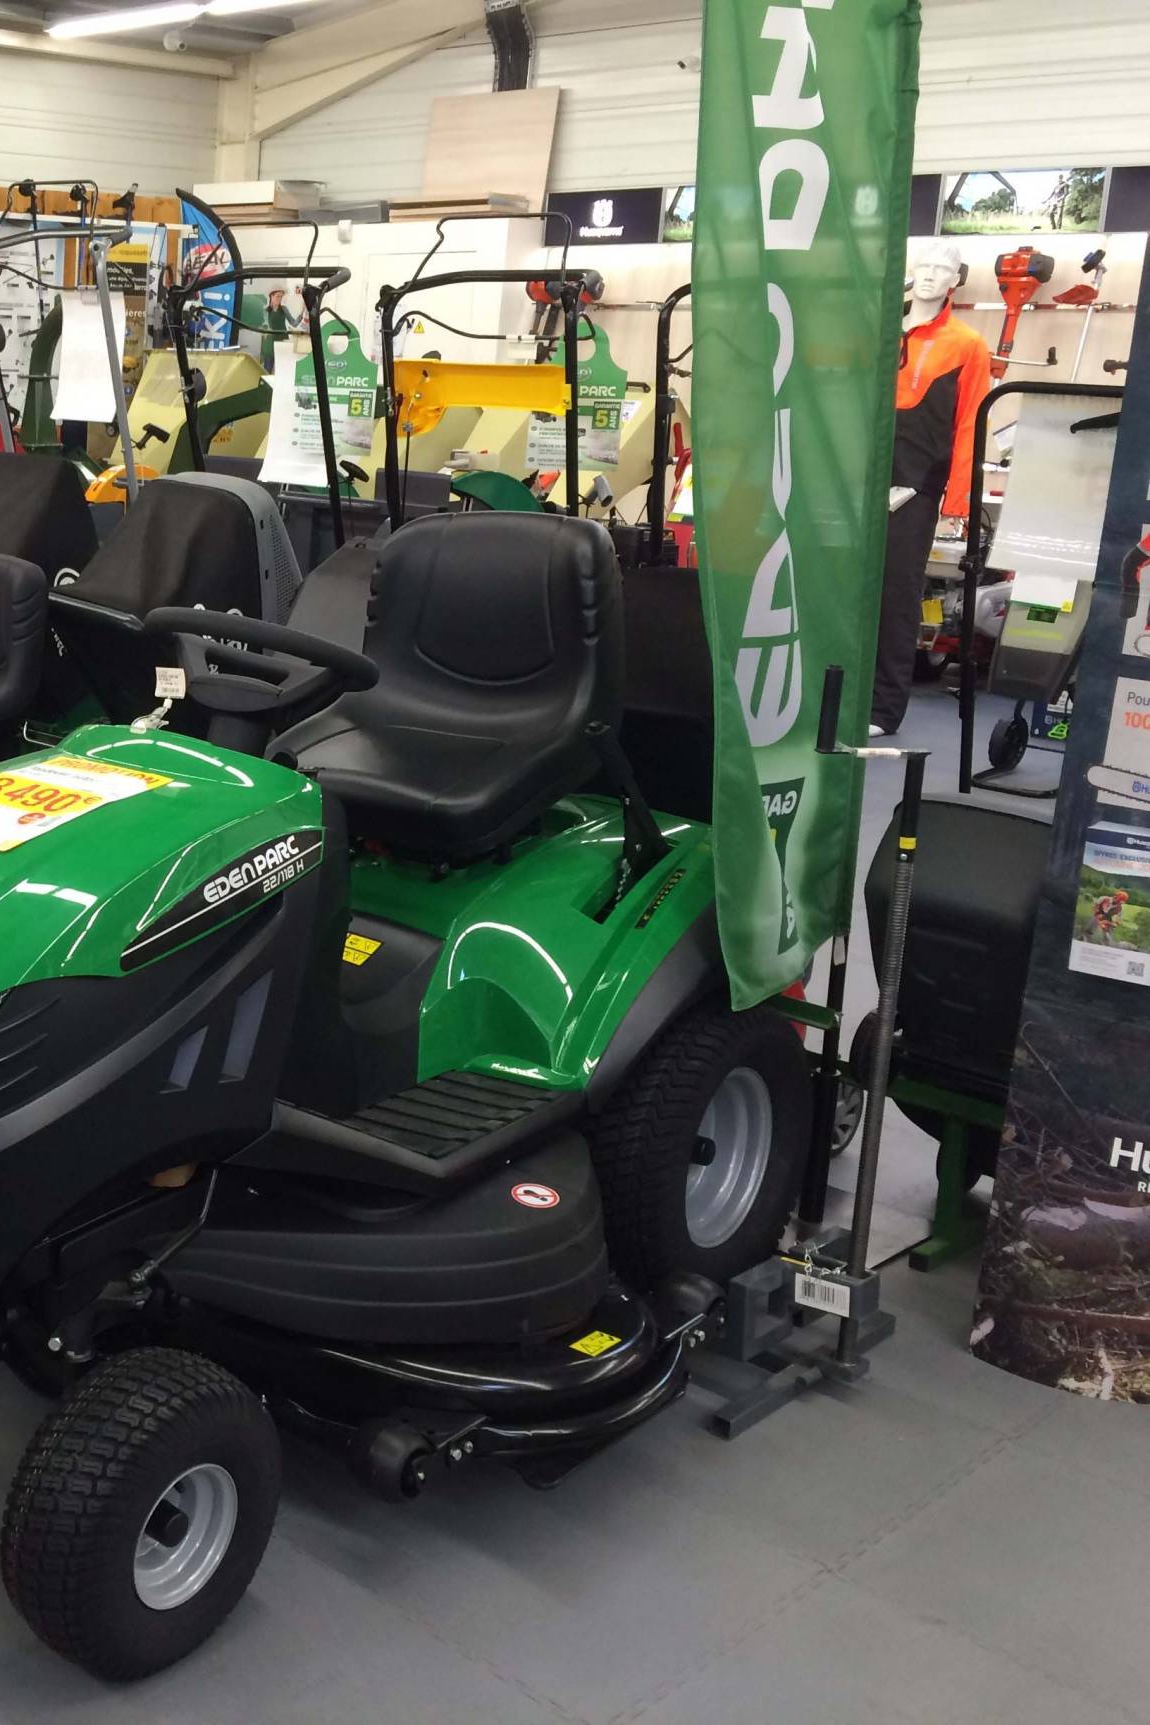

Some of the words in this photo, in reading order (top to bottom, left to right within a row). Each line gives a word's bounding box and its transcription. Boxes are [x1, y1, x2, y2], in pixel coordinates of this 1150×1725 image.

[351, 399, 362, 415] 5
[595, 410, 608, 428] 5
[263, 868, 295, 893] 22/118
[297, 859, 304, 874] H
